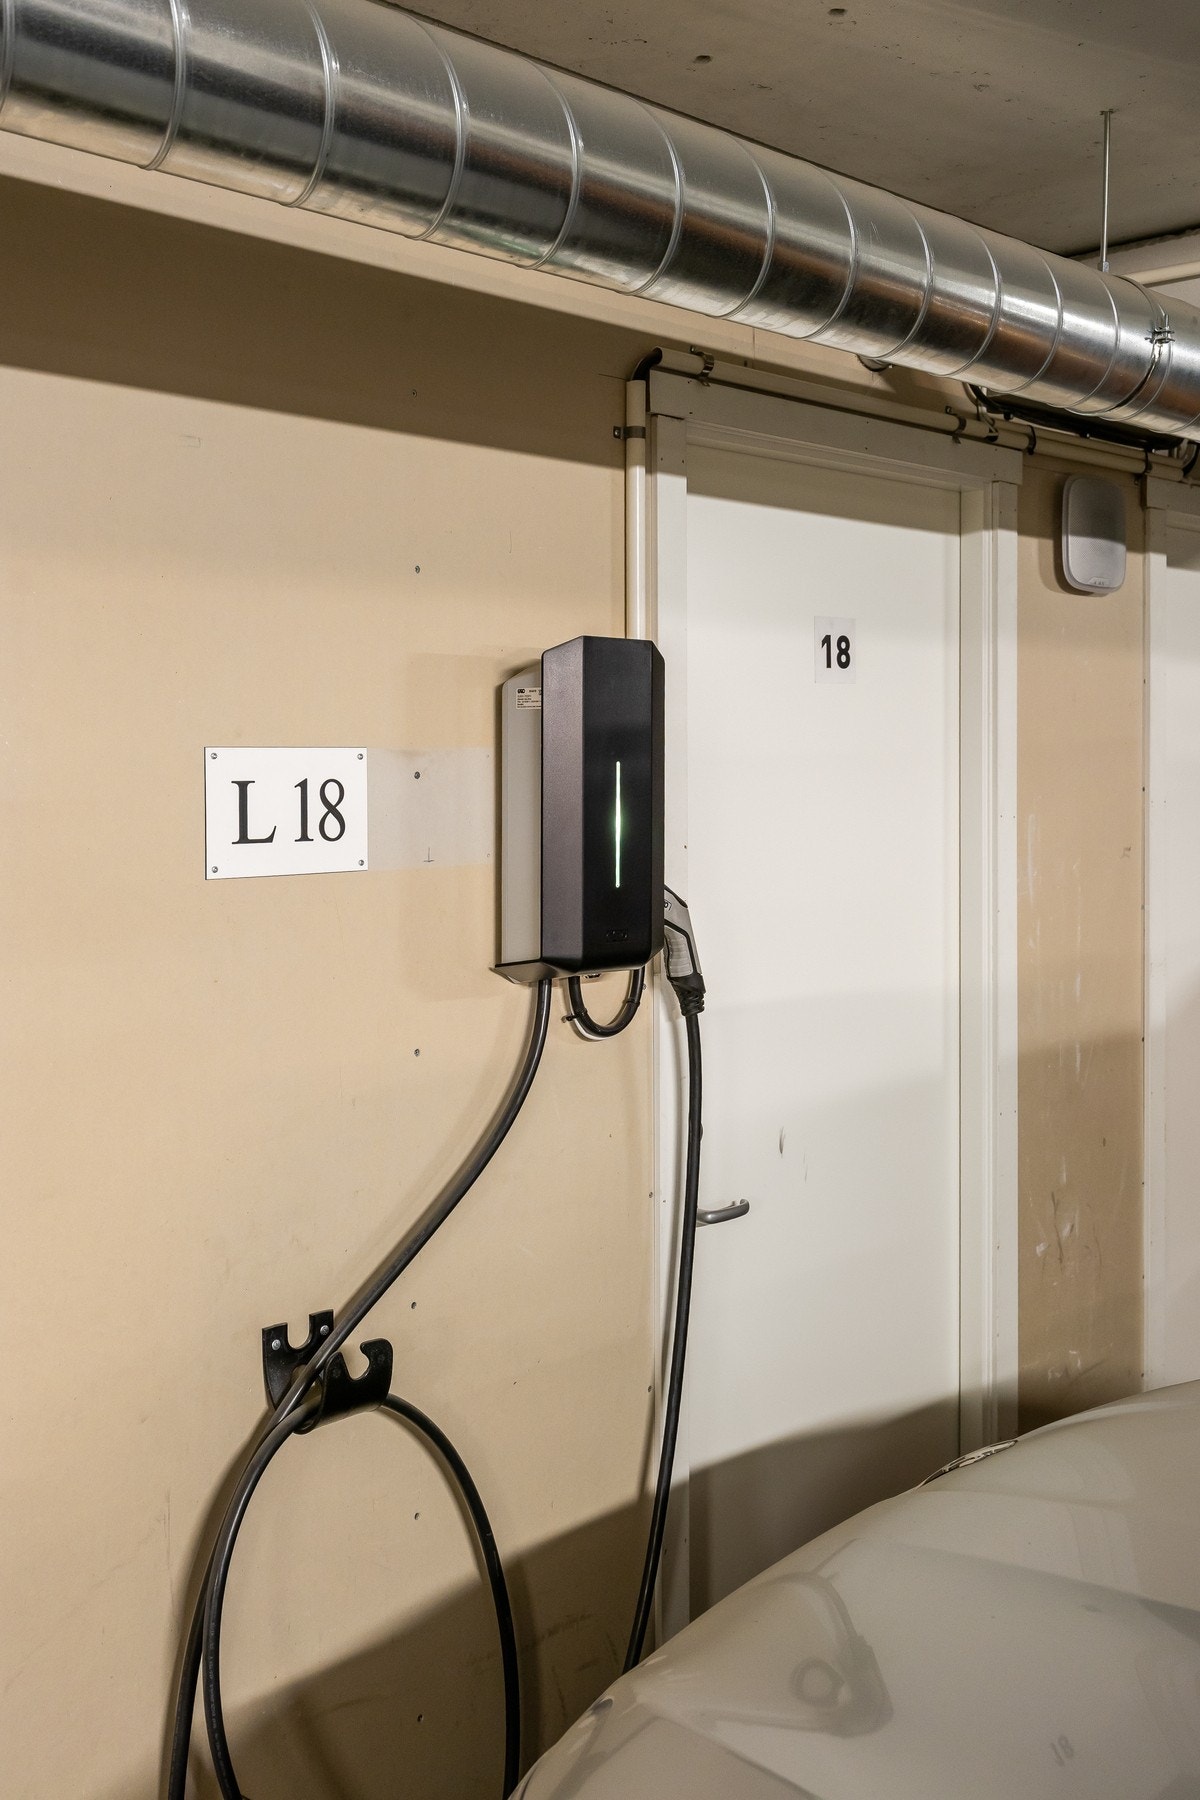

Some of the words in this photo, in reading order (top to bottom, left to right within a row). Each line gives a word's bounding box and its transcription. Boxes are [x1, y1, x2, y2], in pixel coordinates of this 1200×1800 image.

[821, 634, 851, 669] 18
[231, 780, 277, 845] L
[294, 778, 346, 842] 18
